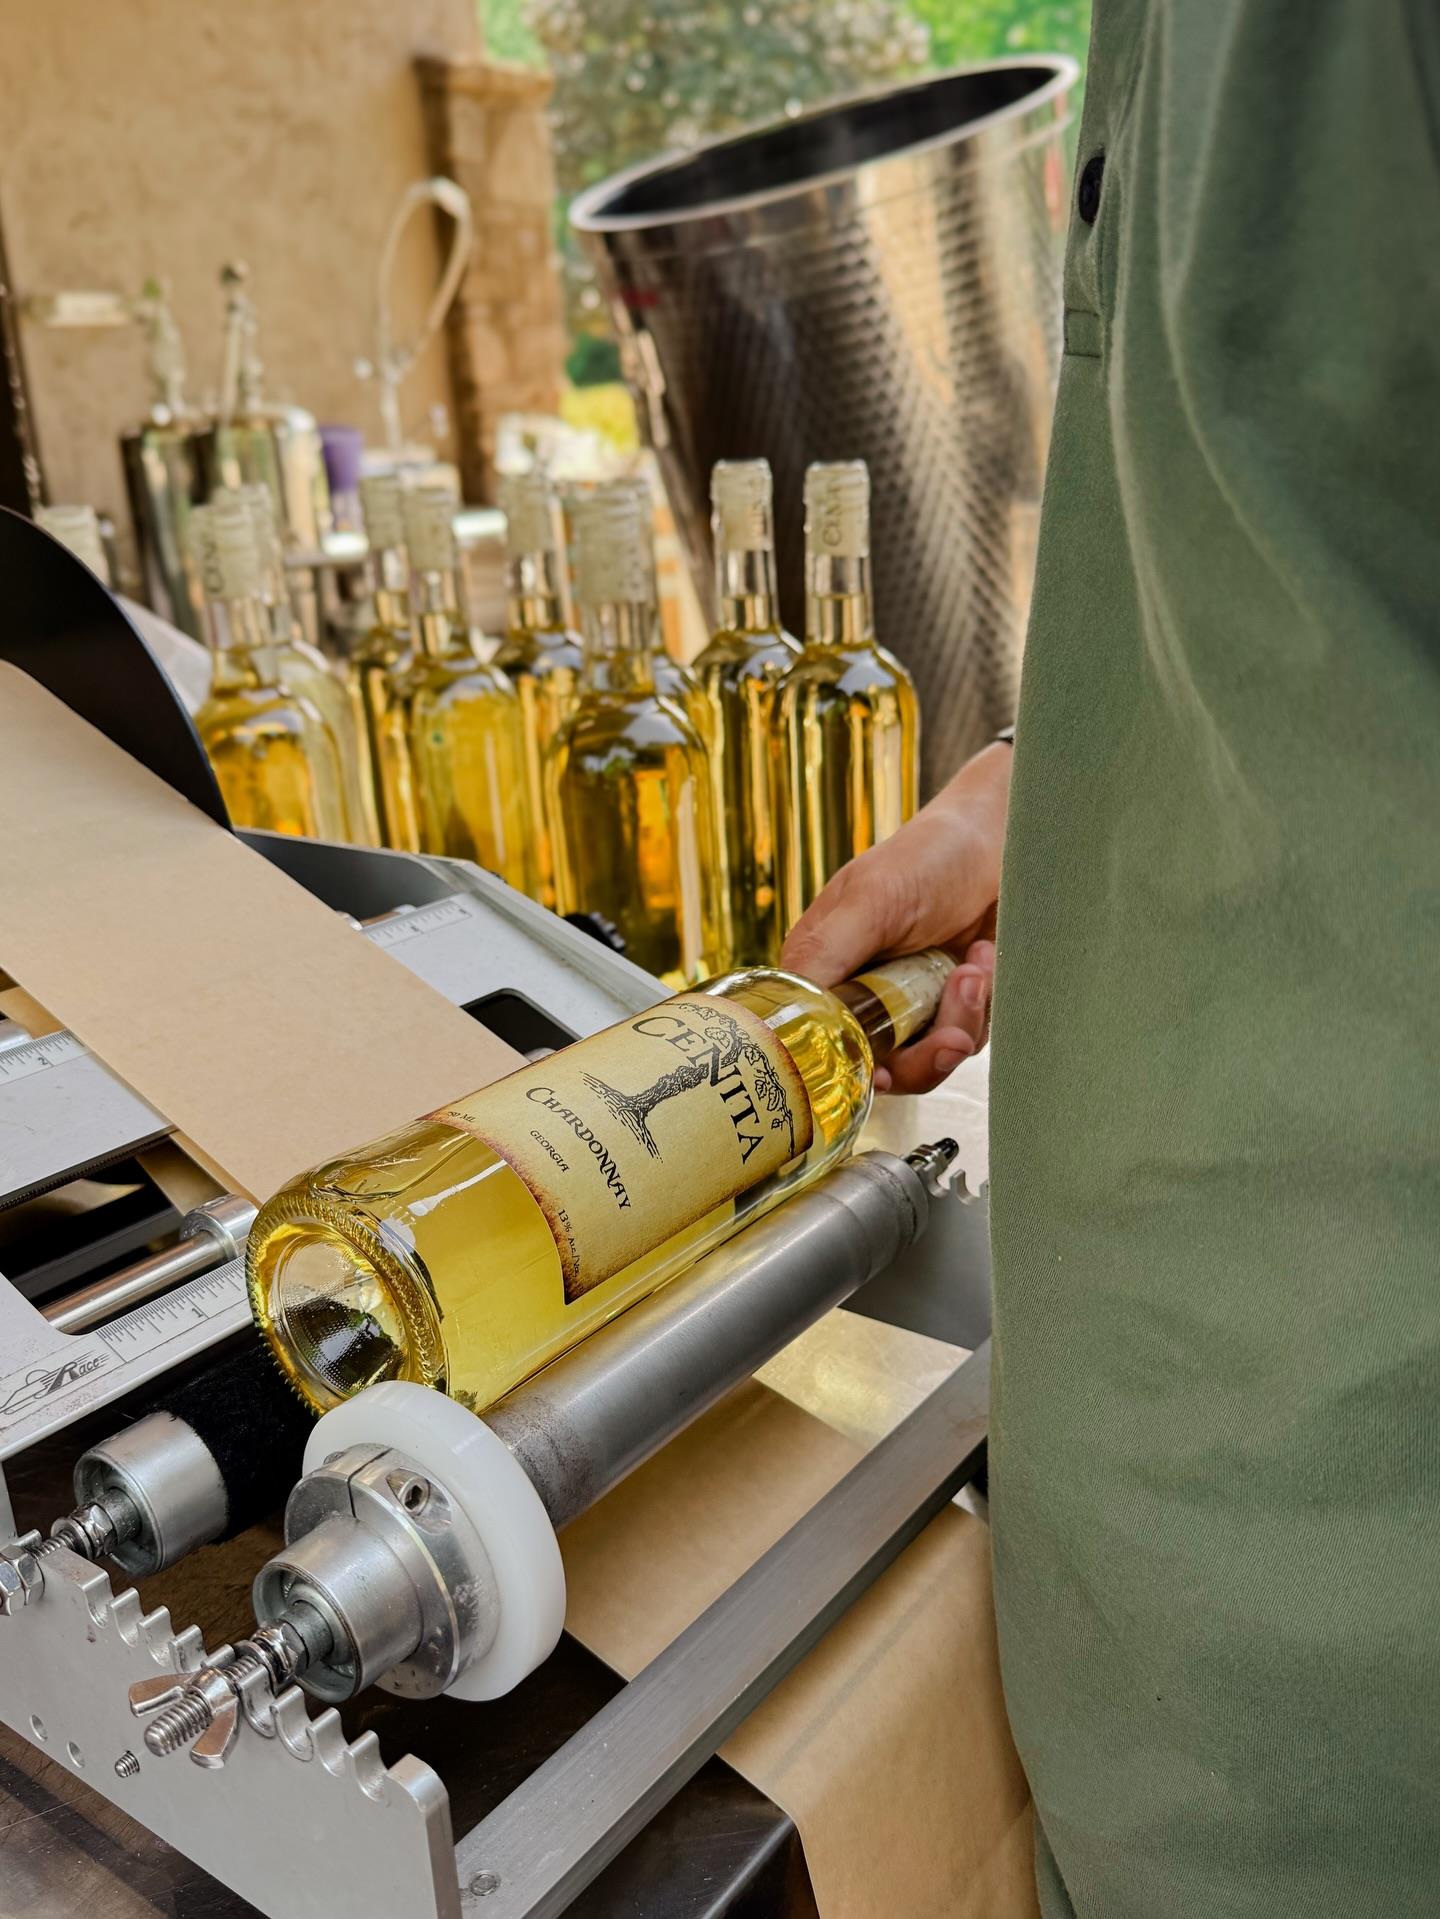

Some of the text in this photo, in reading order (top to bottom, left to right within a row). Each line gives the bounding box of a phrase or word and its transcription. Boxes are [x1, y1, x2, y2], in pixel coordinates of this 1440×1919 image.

[38, 1057, 48, 1065] 2
[631, 1015, 766, 1164] CENITA
[526, 1086, 631, 1210] CHARDONNAY
[530, 1129, 570, 1173] GEORGIA
[558, 1209, 572, 1232] 13%
[47, 1357, 99, 1394] Race
